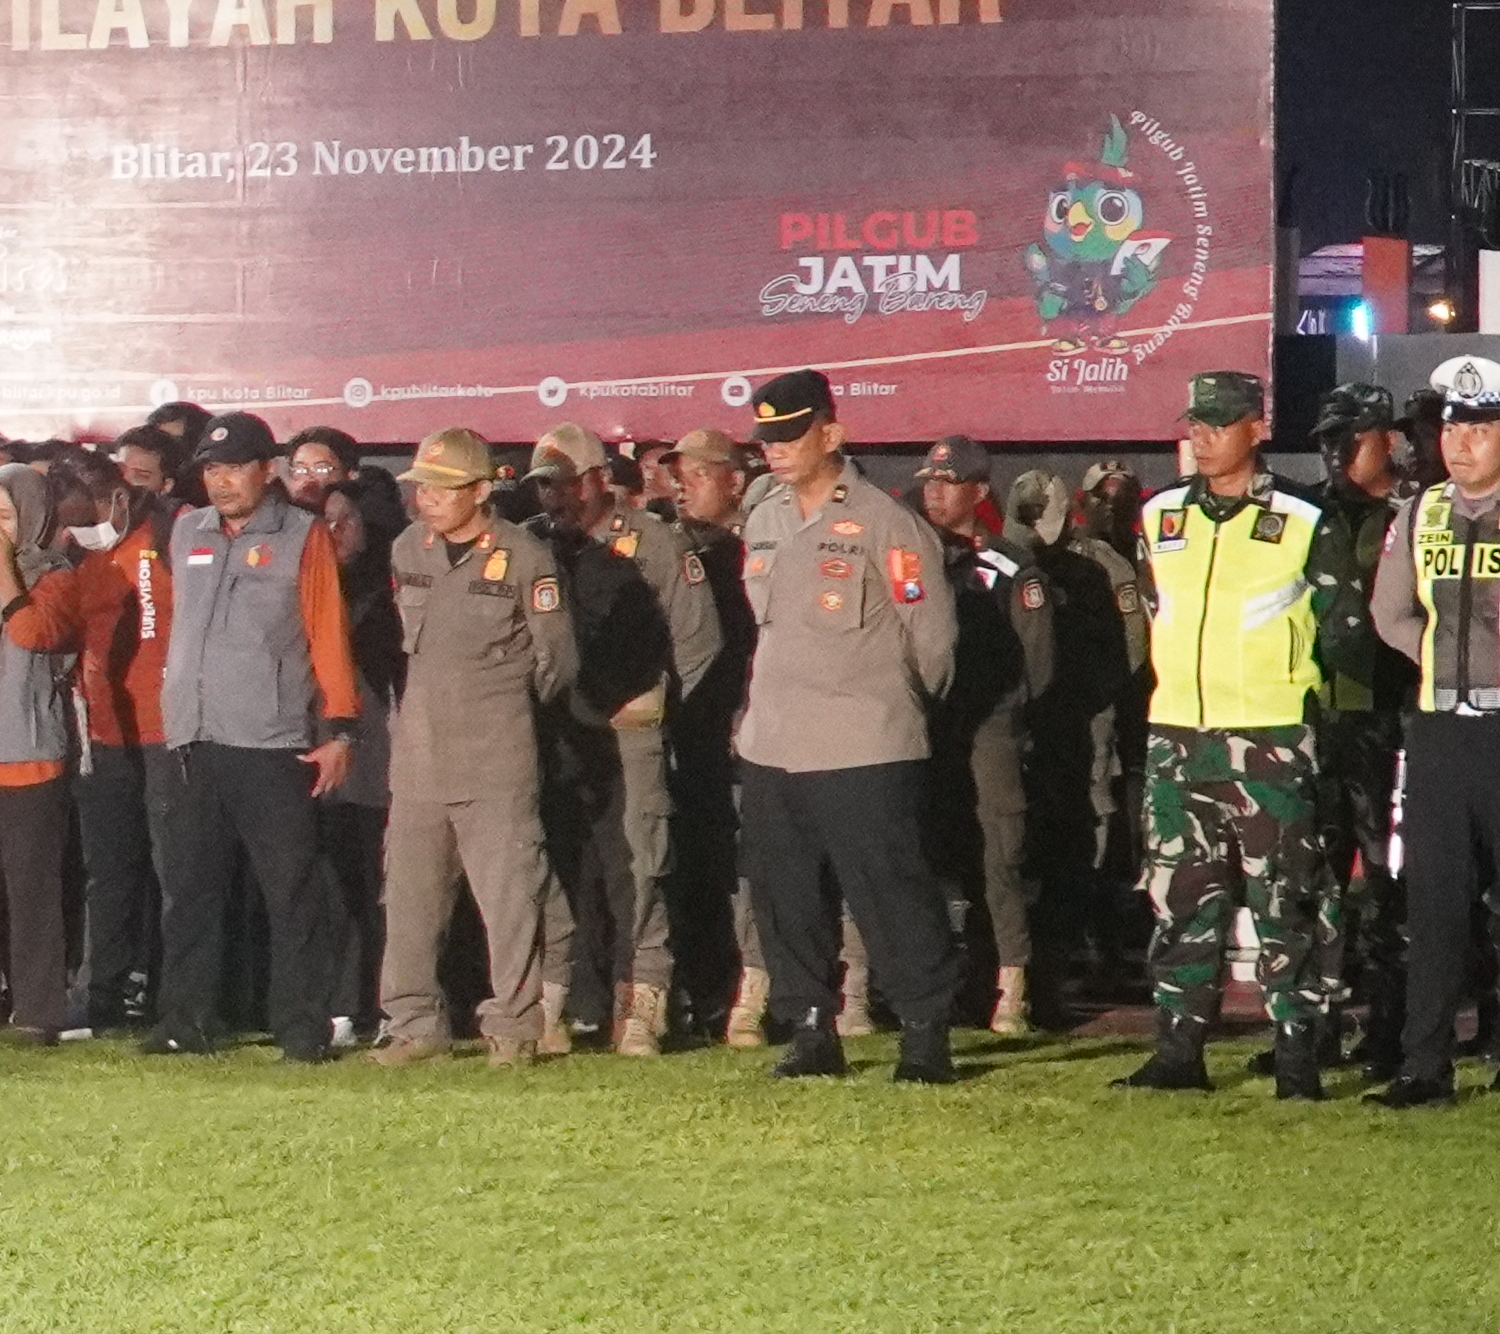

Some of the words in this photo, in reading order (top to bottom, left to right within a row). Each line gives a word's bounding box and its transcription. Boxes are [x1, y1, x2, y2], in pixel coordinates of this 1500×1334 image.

[111, 143, 236, 182] Blitar,
[247, 142, 298, 178] 23
[312, 136, 534, 176] November
[545, 133, 657, 170] 2024
[1130, 110, 1185, 161] Pilgub
[1177, 161, 1208, 218] Jatim
[779, 210, 979, 251] PILGUB
[793, 253, 962, 295] JATIM
[1183, 224, 1212, 301] Seneng
[759, 274, 868, 324] Seneng
[878, 271, 987, 322] Bareng
[1132, 302, 1194, 365] Bareng
[186, 384, 218, 403] kpu
[223, 383, 262, 401] Kota
[266, 382, 312, 400] Blitar
[579, 380, 695, 400] kpukotablitar
[850, 381, 898, 397] Blitar
[1046, 358, 1070, 381] Si
[1073, 357, 1128, 386] Jalih
[1417, 532, 1451, 544] ZEIN
[139, 558, 156, 640] SUPERVISOR
